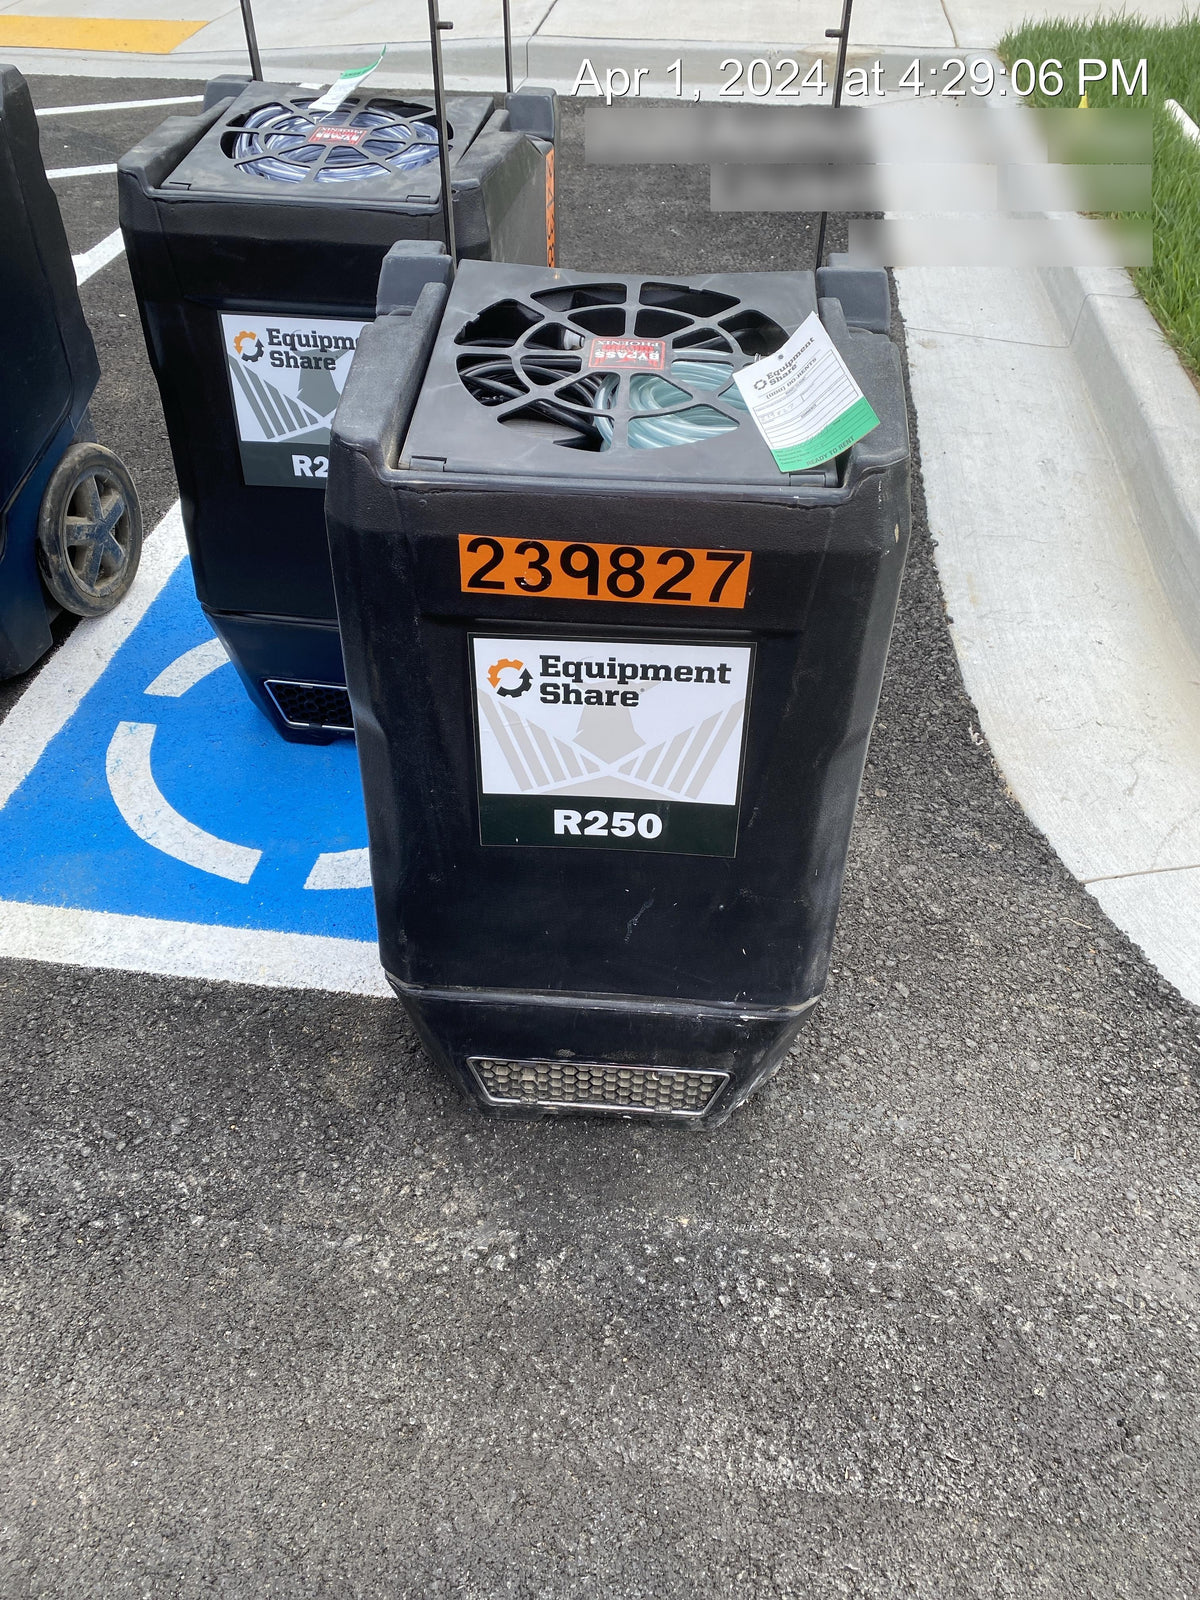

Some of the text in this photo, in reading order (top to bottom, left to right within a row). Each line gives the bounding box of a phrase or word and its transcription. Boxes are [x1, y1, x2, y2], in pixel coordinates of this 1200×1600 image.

[269, 351, 336, 371] Share
[595, 349, 660, 361] BYPASS
[766, 337, 815, 380] Equipment
[769, 364, 797, 386] Share
[828, 447, 839, 458] TO
[839, 435, 856, 451] RENT
[466, 537, 745, 603] 239827
[539, 655, 732, 684] Equipment
[540, 683, 639, 707] Share
[554, 809, 663, 839] R250
